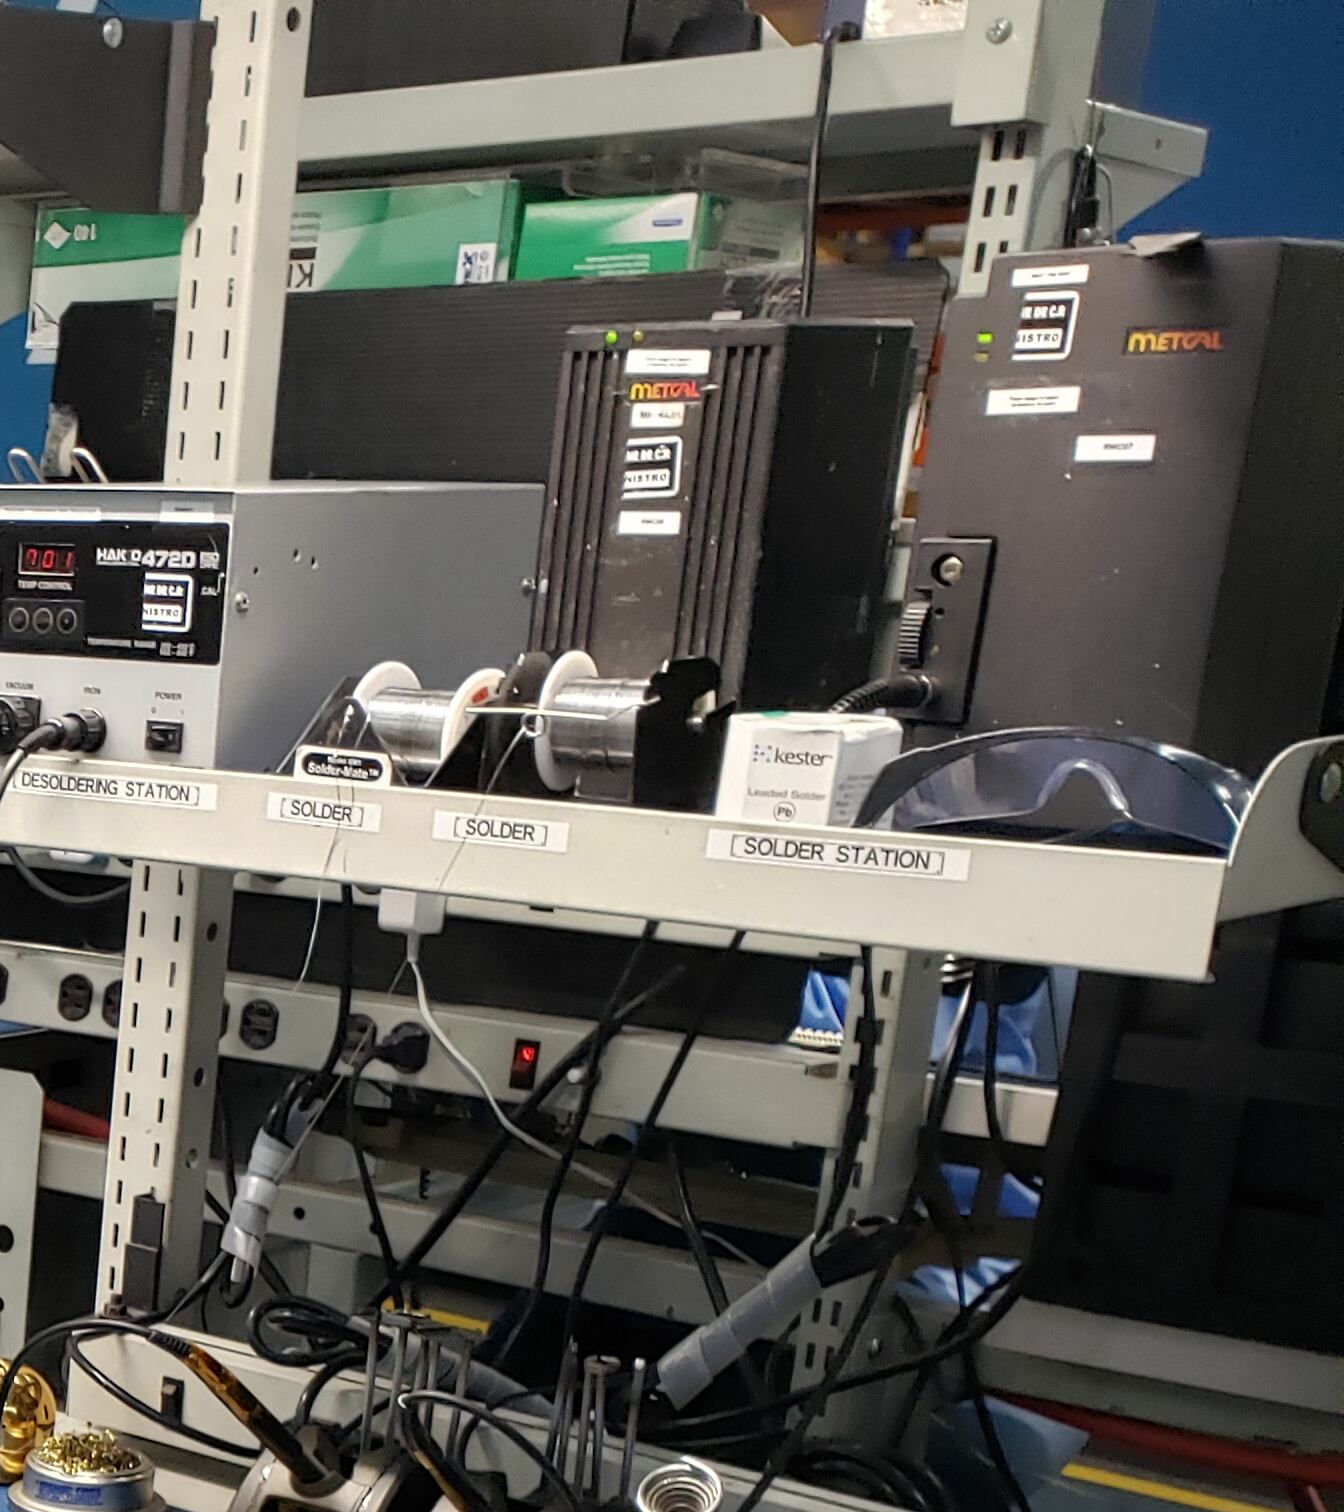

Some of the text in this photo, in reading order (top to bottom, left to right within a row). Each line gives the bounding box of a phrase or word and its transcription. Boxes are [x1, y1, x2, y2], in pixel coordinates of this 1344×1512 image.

[1127, 331, 1224, 353] METCAL
[630, 381, 700, 400] METCAL
[26, 548, 74, 569] 701
[155, 692, 182, 700] POWER
[774, 747, 829, 766] kester
[21, 771, 191, 802] DESOLDERING STATION
[791, 790, 826, 801] Solder
[290, 800, 352, 823] SOLDER
[777, 805, 792, 818] Pb
[465, 819, 535, 841] SOLDER
[744, 836, 932, 870] SOLDER STATION
